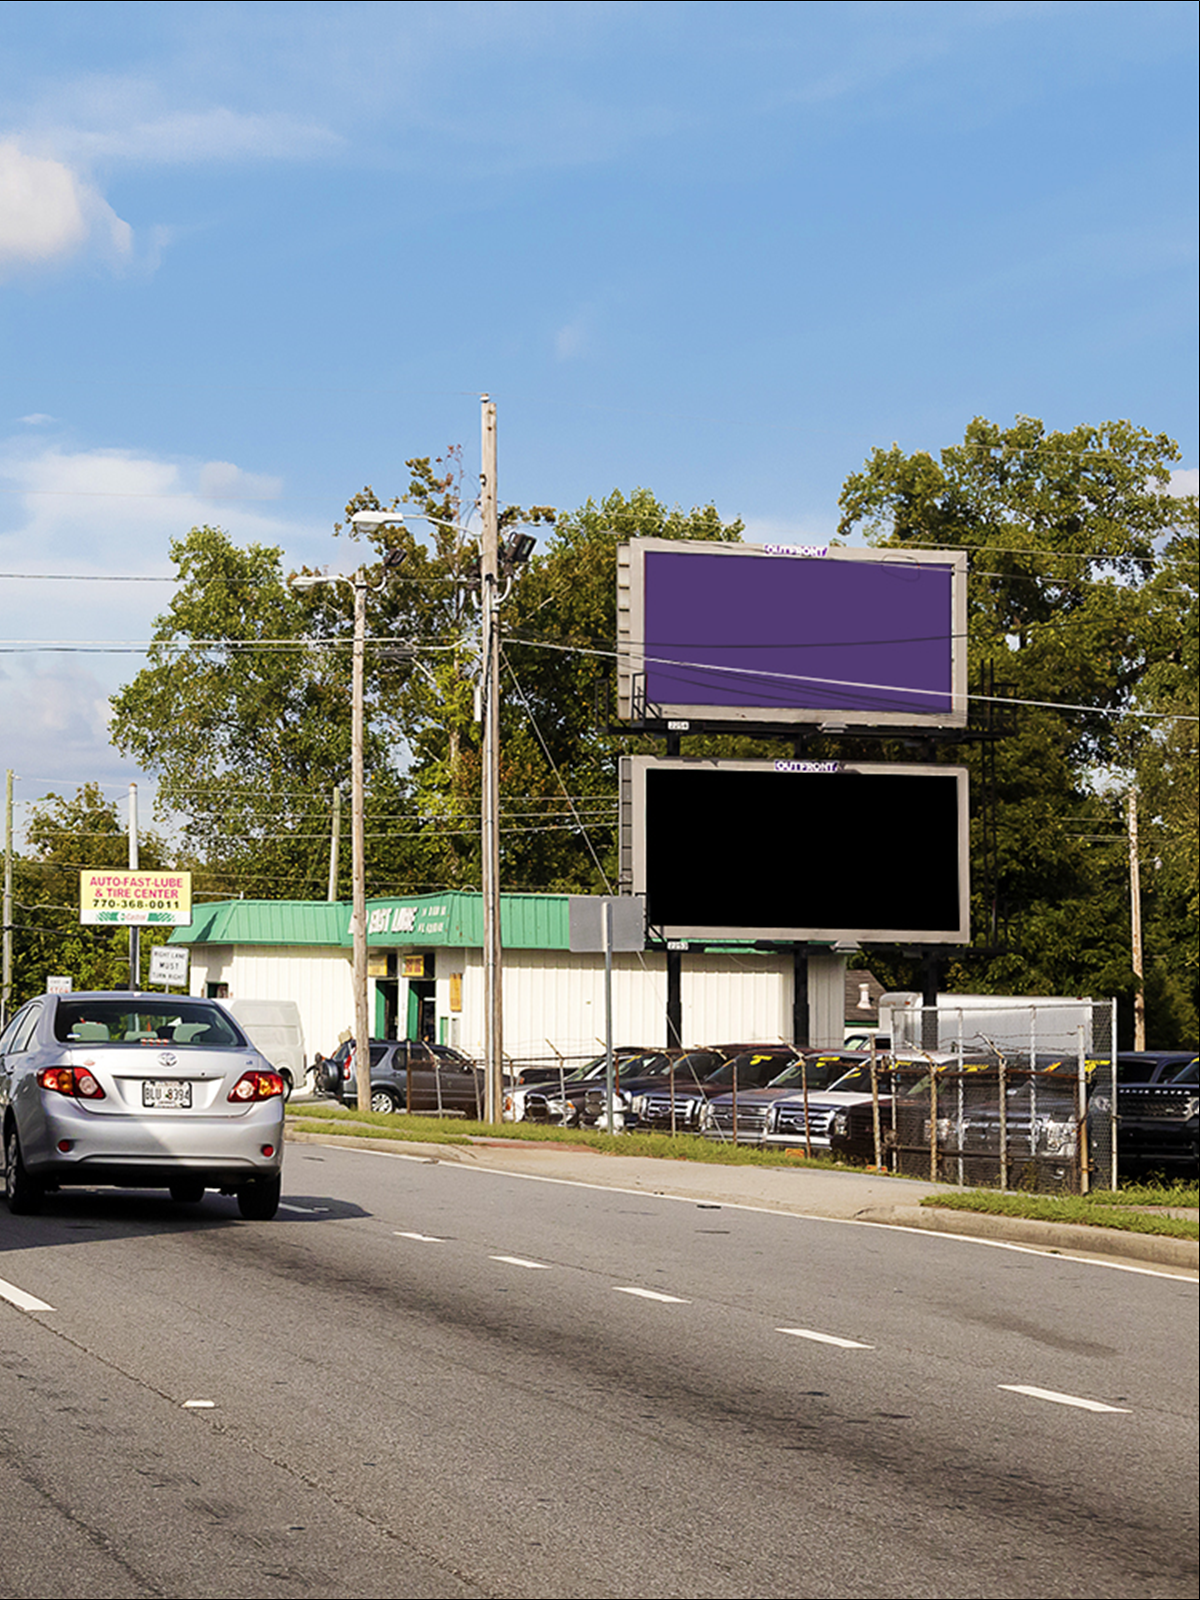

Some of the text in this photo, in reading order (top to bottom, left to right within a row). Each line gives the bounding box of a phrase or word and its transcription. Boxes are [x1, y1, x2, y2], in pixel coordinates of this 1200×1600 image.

[95, 888, 179, 899] & TIRE CENTER
[93, 899, 180, 909] 770-368-0011
